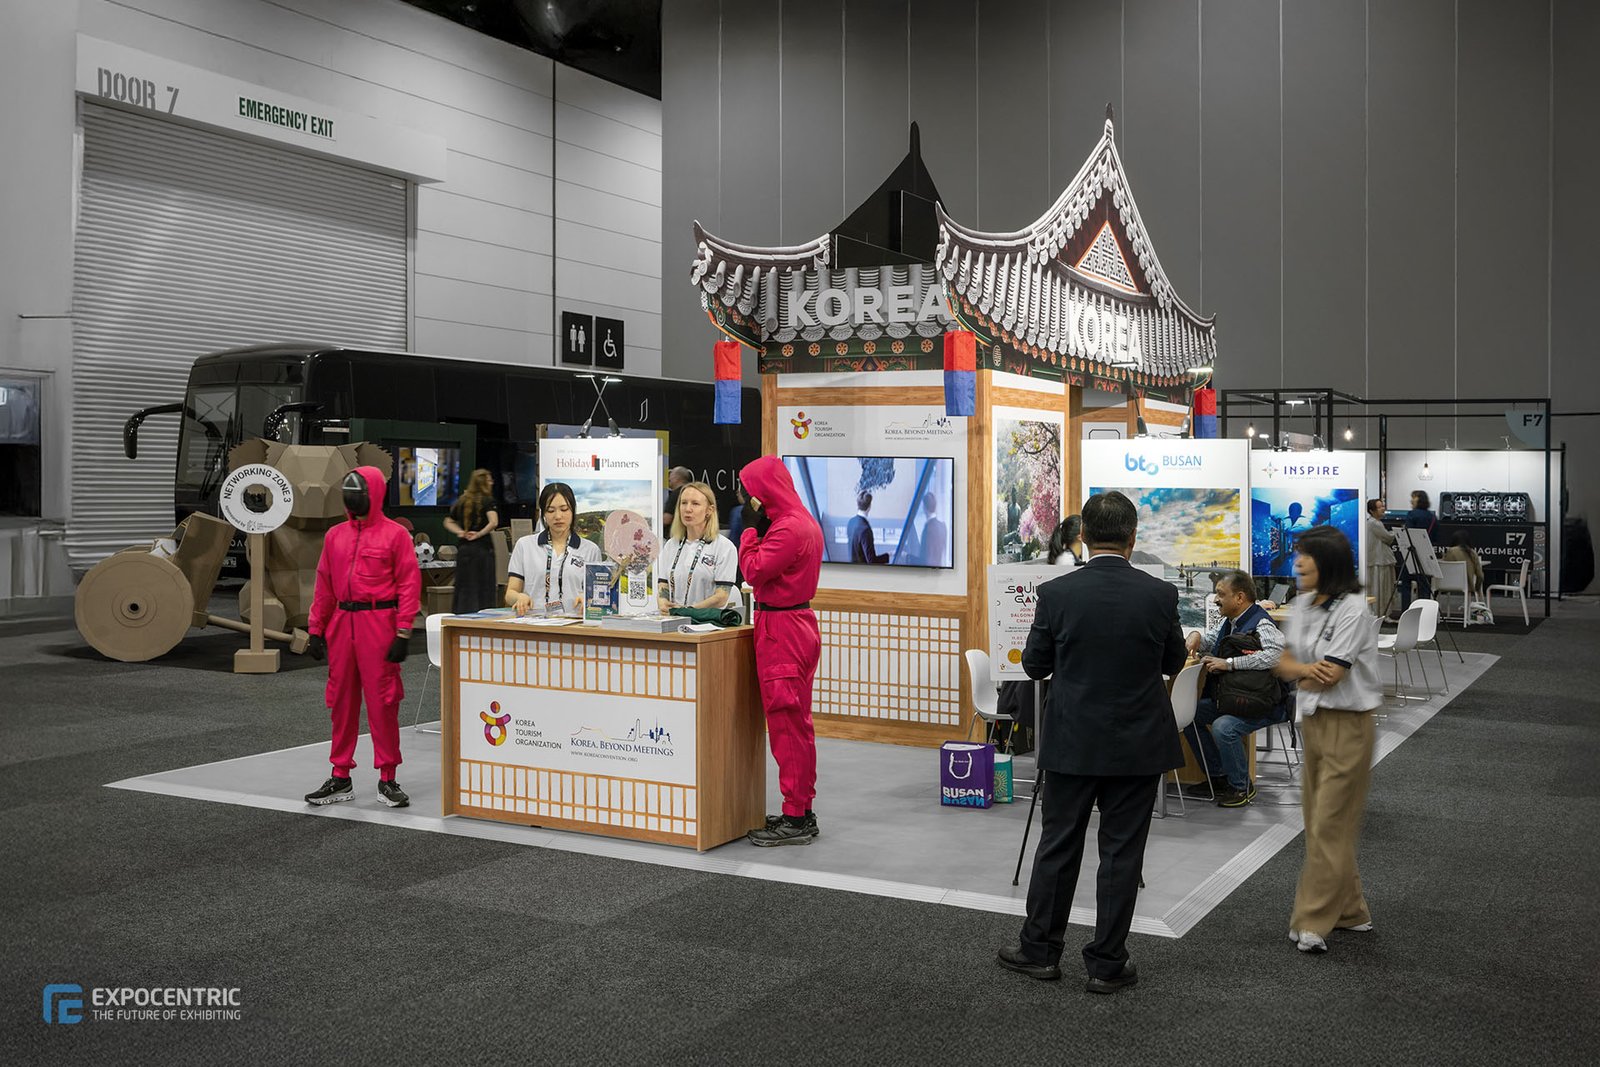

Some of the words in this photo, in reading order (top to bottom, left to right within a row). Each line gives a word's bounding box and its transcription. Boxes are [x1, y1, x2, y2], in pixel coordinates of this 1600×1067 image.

[98, 67, 155, 111] DOOR
[166, 86, 180, 114] 7
[239, 97, 308, 131] EMERGENCY
[311, 115, 334, 138] EXIT
[788, 284, 951, 326] KOREA
[1069, 299, 1143, 364] KOREA
[1524, 414, 1543, 426] F7
[556, 458, 590, 471] Holiday
[601, 458, 640, 469] Planners
[1162, 456, 1202, 466] BUSAN
[1284, 466, 1340, 476] INSPIRE
[224, 468, 272, 500] NETWORKING
[272, 474, 290, 496] ZONE
[1506, 533, 1526, 546] F7
[1004, 582, 1039, 594] SQUI
[1014, 596, 1040, 607] GAM
[515, 720, 536, 728] KOREA
[515, 729, 542, 738] TOURISM
[515, 739, 562, 750] ORGANIZATION
[600, 741, 632, 752] BEYOND
[632, 744, 674, 757] MEETINGS
[942, 786, 984, 798] BUSAN
